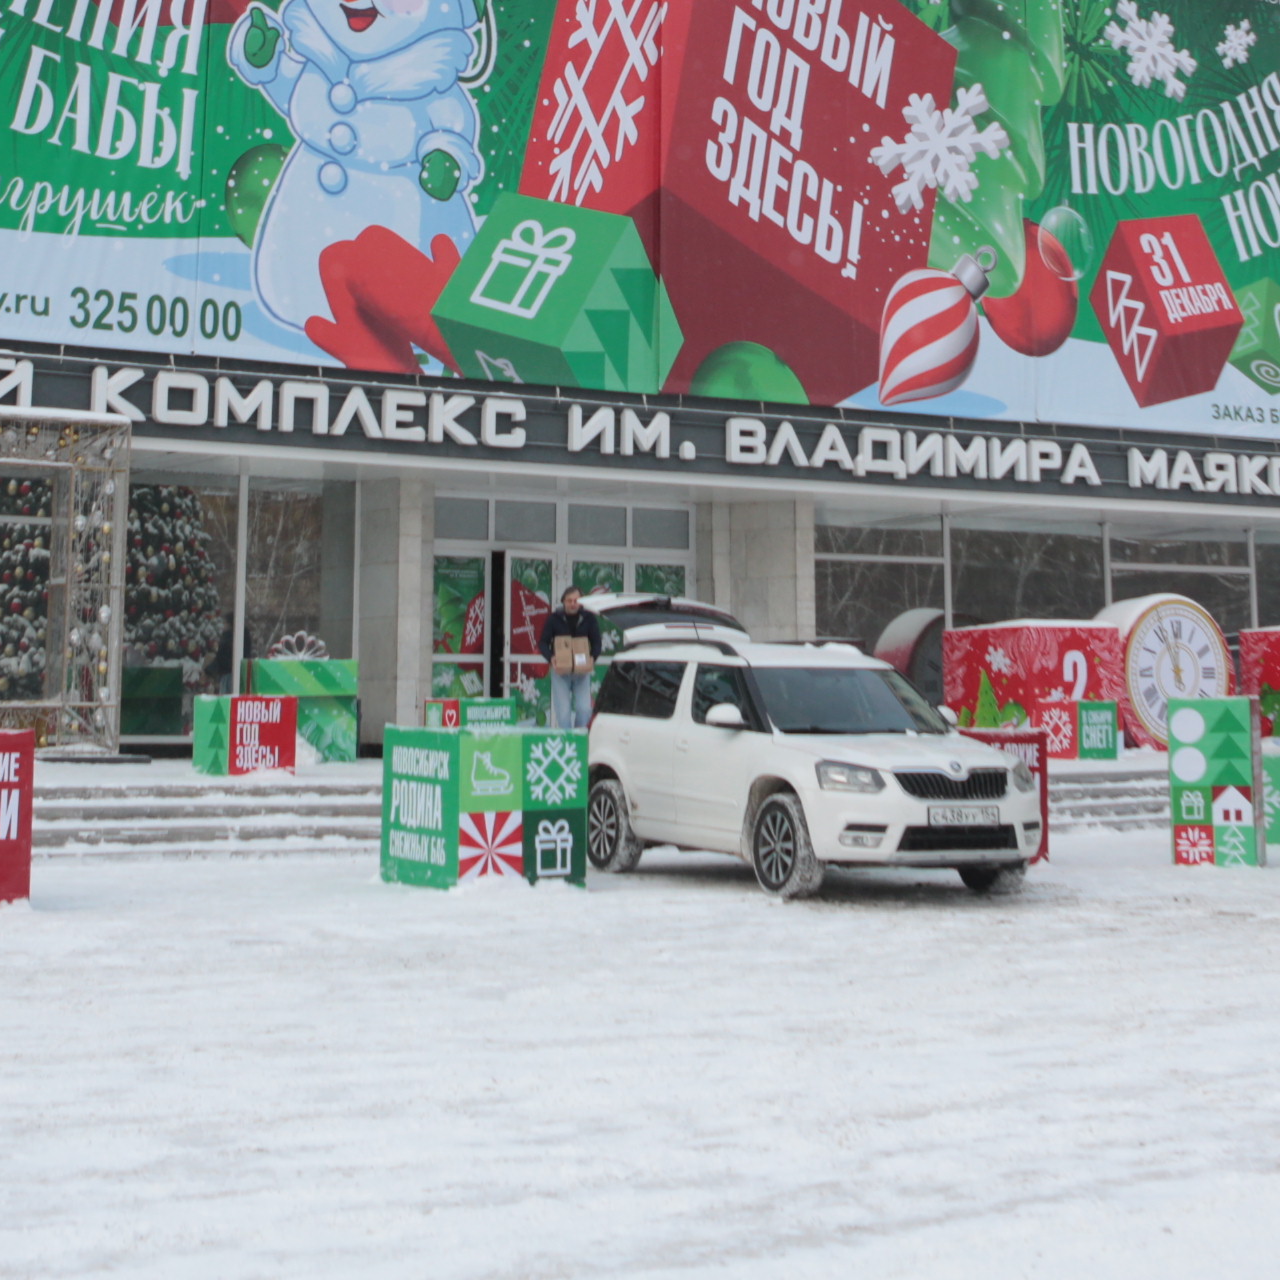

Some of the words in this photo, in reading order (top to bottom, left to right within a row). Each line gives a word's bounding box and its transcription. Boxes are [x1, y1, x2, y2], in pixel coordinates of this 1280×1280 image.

[723, 5, 810, 151] ГОД
[9, 44, 199, 180] БАБЫ
[705, 96, 864, 281] ЗДЕСЬ!
[1139, 231, 1193, 289] 31
[69, 286, 138, 333] 325
[146, 295, 188, 338] 00
[200, 298, 243, 341] 00
[1159, 283, 1233, 324] ДЕКАБРЯ
[92, 365, 526, 449] КОМПЛЕКС
[568, 404, 695, 460] ИМ.
[726, 416, 1101, 485] ВЛАДИМИРА
[1211, 403, 1264, 423] ЗАКАЗ
[236, 723, 260, 747] ГОД
[237, 699, 282, 724] НОВЫЙ
[236, 746, 279, 771] ЗДЕСЬ!
[392, 745, 450, 780] НОВОСИБИРСК
[390, 778, 442, 831] РОДИНА
[389, 828, 429, 863] СНЕЖНЫХ
[431, 836, 446, 866] БАБ
